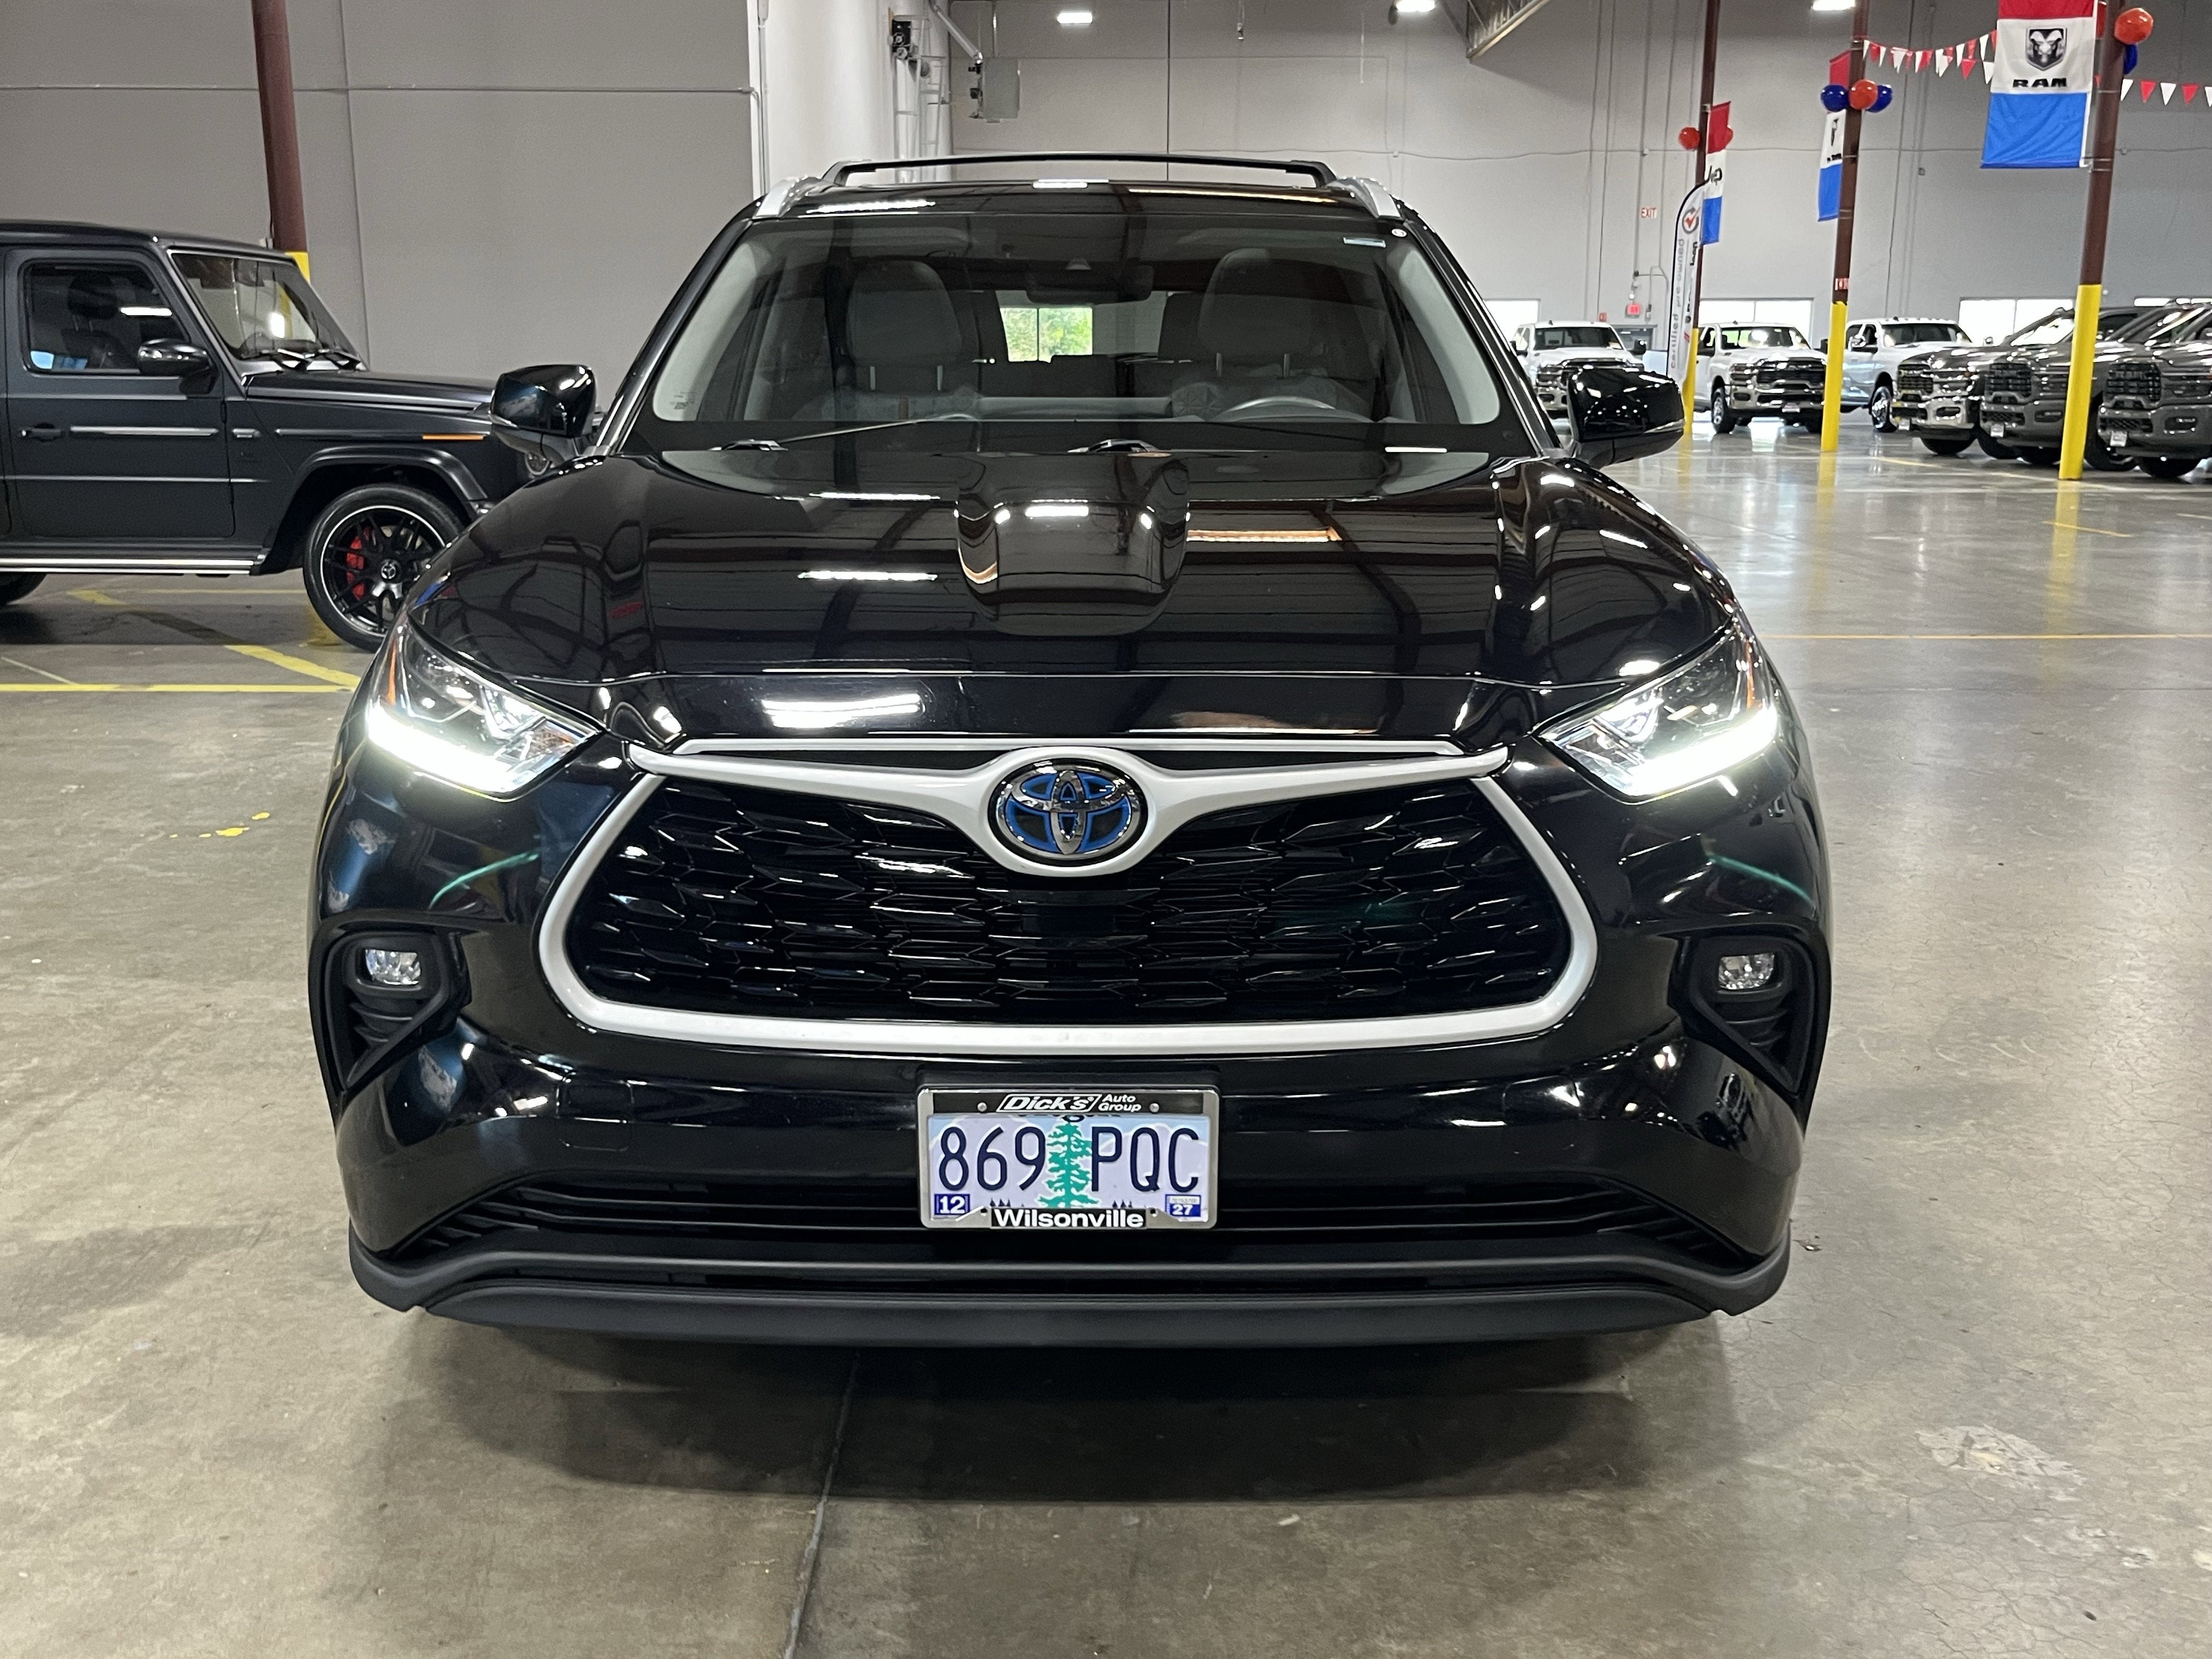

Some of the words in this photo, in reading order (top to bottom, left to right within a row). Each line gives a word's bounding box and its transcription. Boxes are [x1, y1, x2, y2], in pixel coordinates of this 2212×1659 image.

[2012, 77, 2067, 88] RAM
[1641, 207, 1657, 218] EXIT
[1003, 1096, 1086, 1110] Dick's
[1102, 1094, 1136, 1103] Auto
[1098, 1102, 1142, 1113] Group
[939, 1126, 1046, 1191] 869
[1091, 1126, 1199, 1193] PQC
[940, 1195, 965, 1214] 12
[1172, 1204, 1193, 1216] 27
[995, 1209, 1144, 1228] Wilsonville
